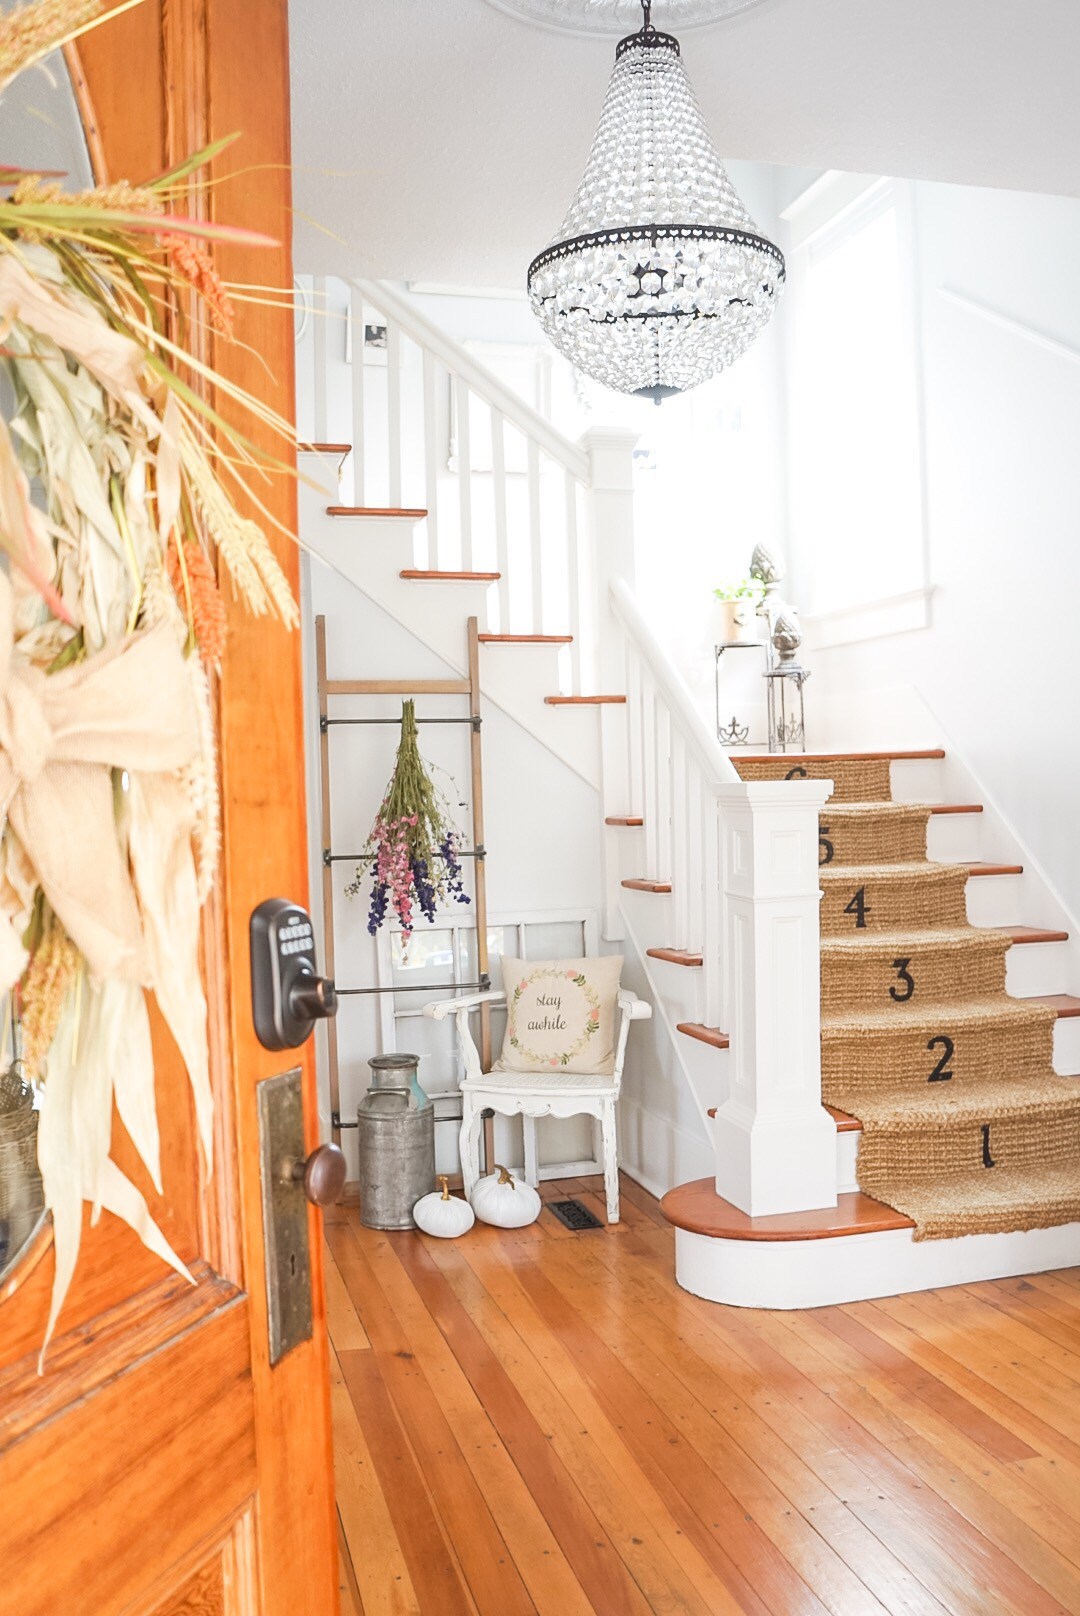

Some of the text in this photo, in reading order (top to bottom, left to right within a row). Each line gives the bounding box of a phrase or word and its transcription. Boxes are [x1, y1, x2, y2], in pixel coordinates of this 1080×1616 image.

[818, 826, 834, 866] 5
[843, 885, 871, 928] 4
[536, 993, 561, 1010] stay
[889, 958, 914, 1002] 3
[527, 1014, 566, 1030] awhile
[927, 1036, 954, 1082] 2
[981, 1124, 995, 1168] 1
